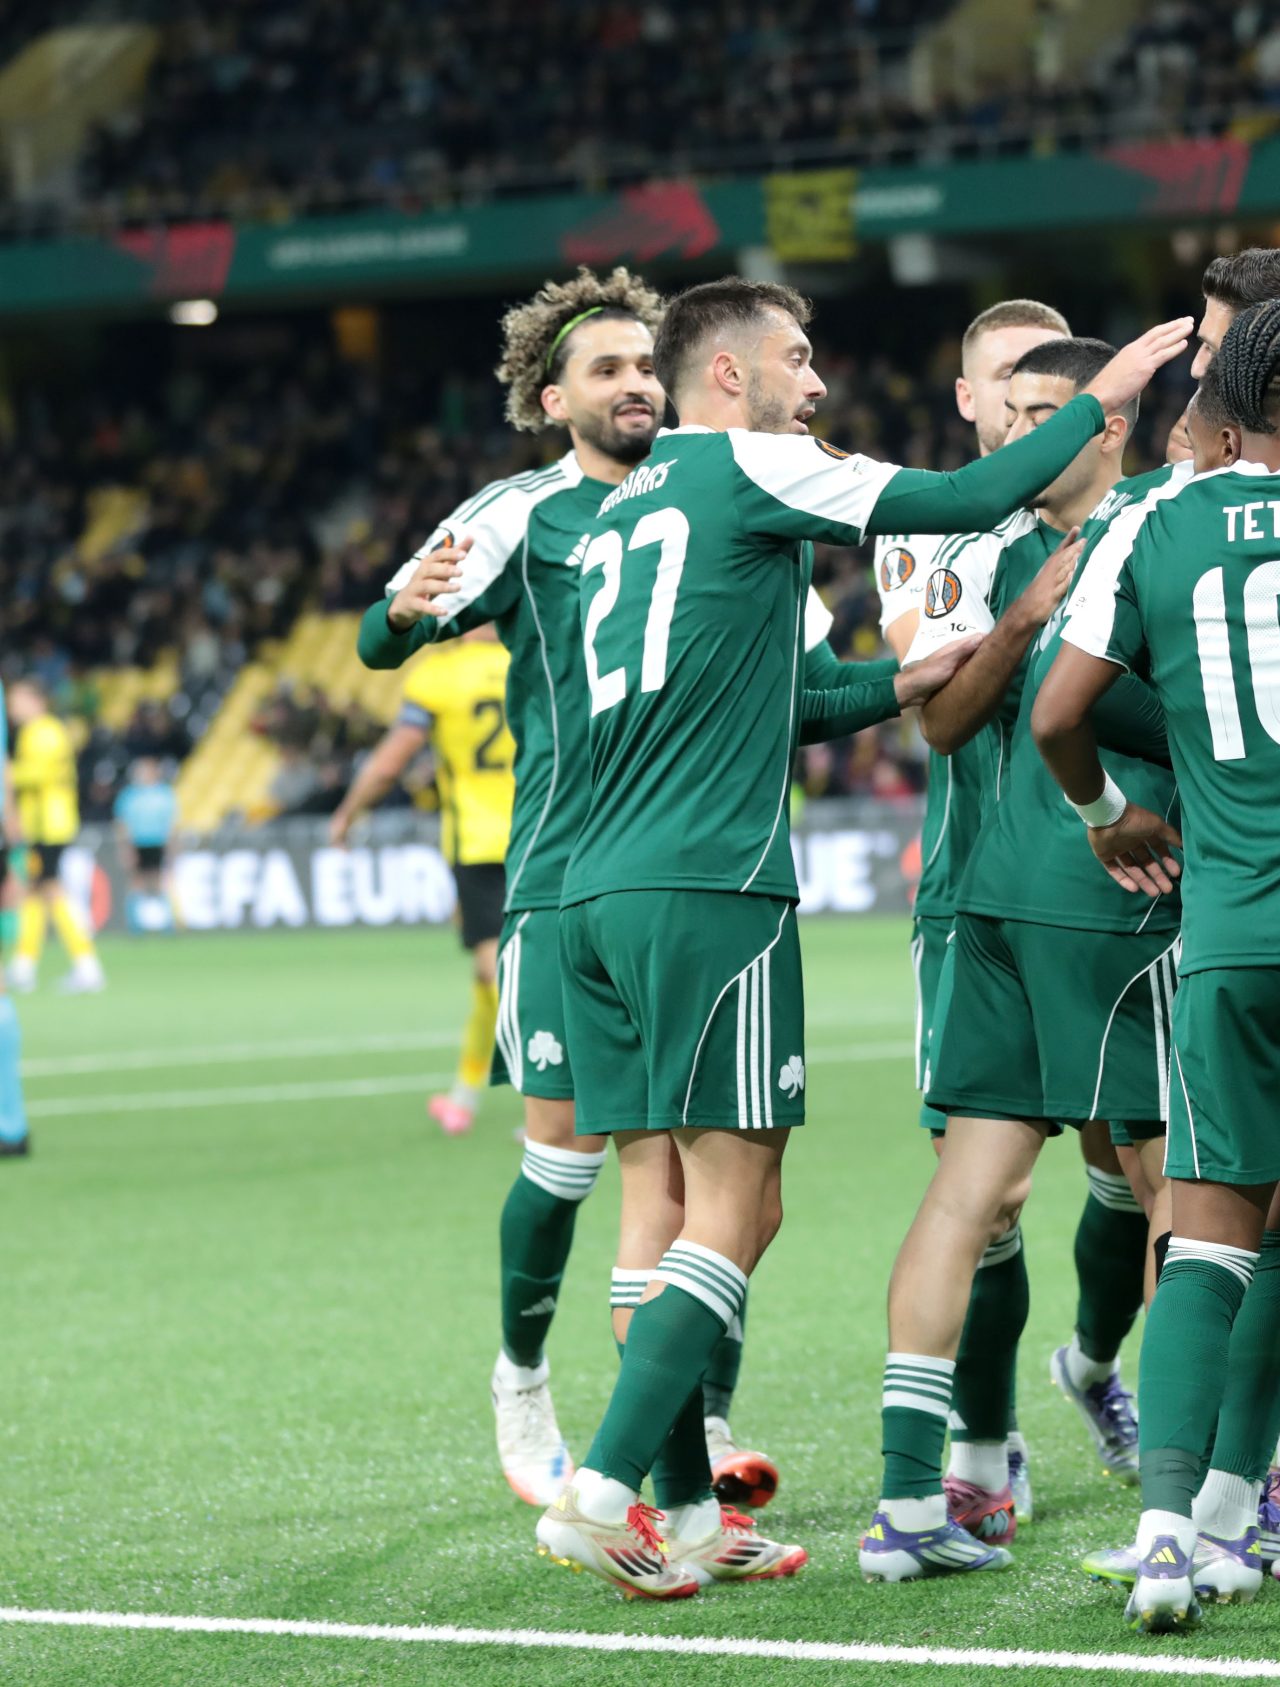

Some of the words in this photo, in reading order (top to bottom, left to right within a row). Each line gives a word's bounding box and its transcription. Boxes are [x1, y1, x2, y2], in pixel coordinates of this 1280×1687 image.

[577, 506, 690, 719] 27
[135, 846, 309, 930] EFA
[311, 843, 458, 926] EUR
